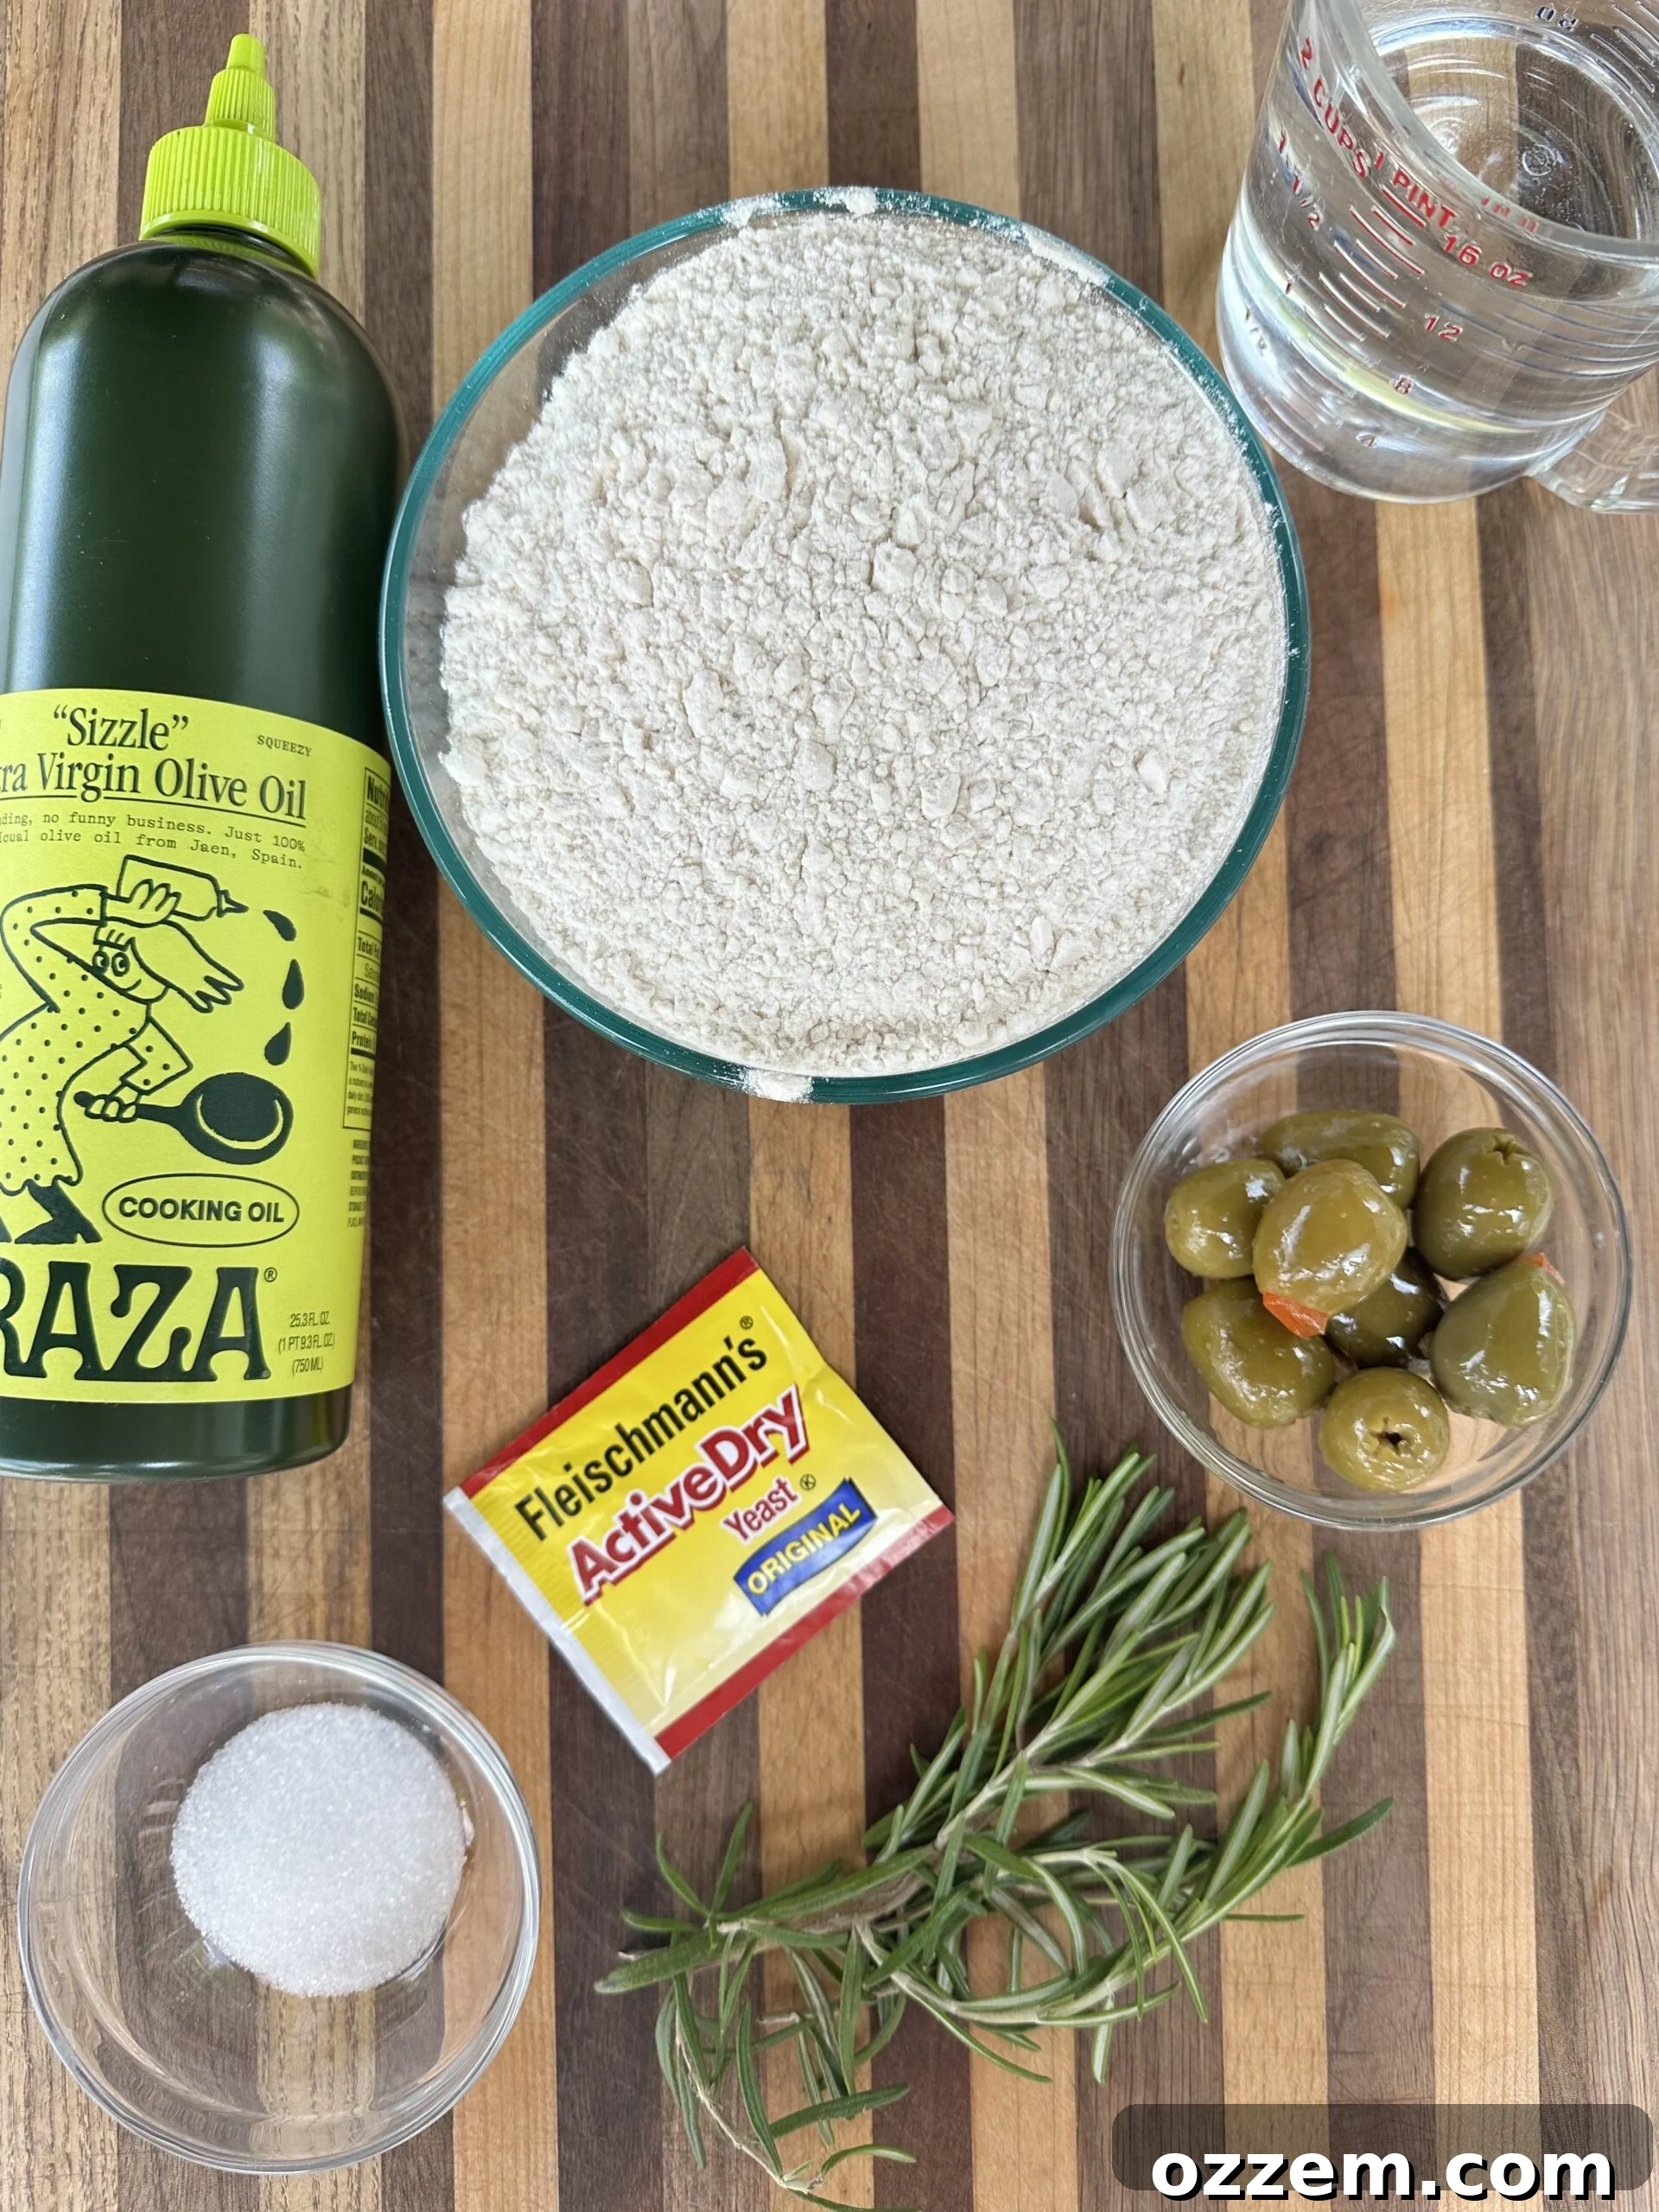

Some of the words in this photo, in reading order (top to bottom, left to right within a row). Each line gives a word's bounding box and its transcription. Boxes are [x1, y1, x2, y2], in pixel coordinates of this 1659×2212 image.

[1313, 75, 1370, 178] CUPS
[1390, 168, 1457, 228] PINT
[1442, 233, 1483, 267] 16
[1488, 261, 1534, 288] OZ
[1425, 314, 1464, 344] 12
[1392, 375, 1415, 396] 8
[257, 734, 312, 757] SQUEEZY
[0, 763, 29, 793] ra
[37, 752, 142, 803] Virgin
[155, 758, 248, 807] Olive
[259, 775, 307, 820] Oil
[0, 813, 32, 826] ding,
[43, 814, 59, 823] no
[69, 811, 116, 827] funny
[127, 815, 211, 835] business.
[225, 826, 262, 843] Just
[273, 835, 305, 851] 100%
[41, 830, 81, 842] olive
[94, 831, 121, 844] oil
[136, 834, 176, 849] from
[190, 839, 236, 858] Jaen,
[251, 849, 302, 868] Spain.
[119, 1196, 242, 1222] COOKING
[248, 1201, 284, 1223] OIL
[290, 1313, 308, 1328] 25.3
[289, 1336, 300, 1351] PT
[301, 1334, 312, 1350] 9.3
[292, 1357, 309, 1376] (750
[310, 1356, 323, 1374] ML)
[515, 1335, 767, 1541] Fleischmann's
[721, 1476, 798, 1541] Yeast
[747, 1503, 861, 1594] ORIGINAL
